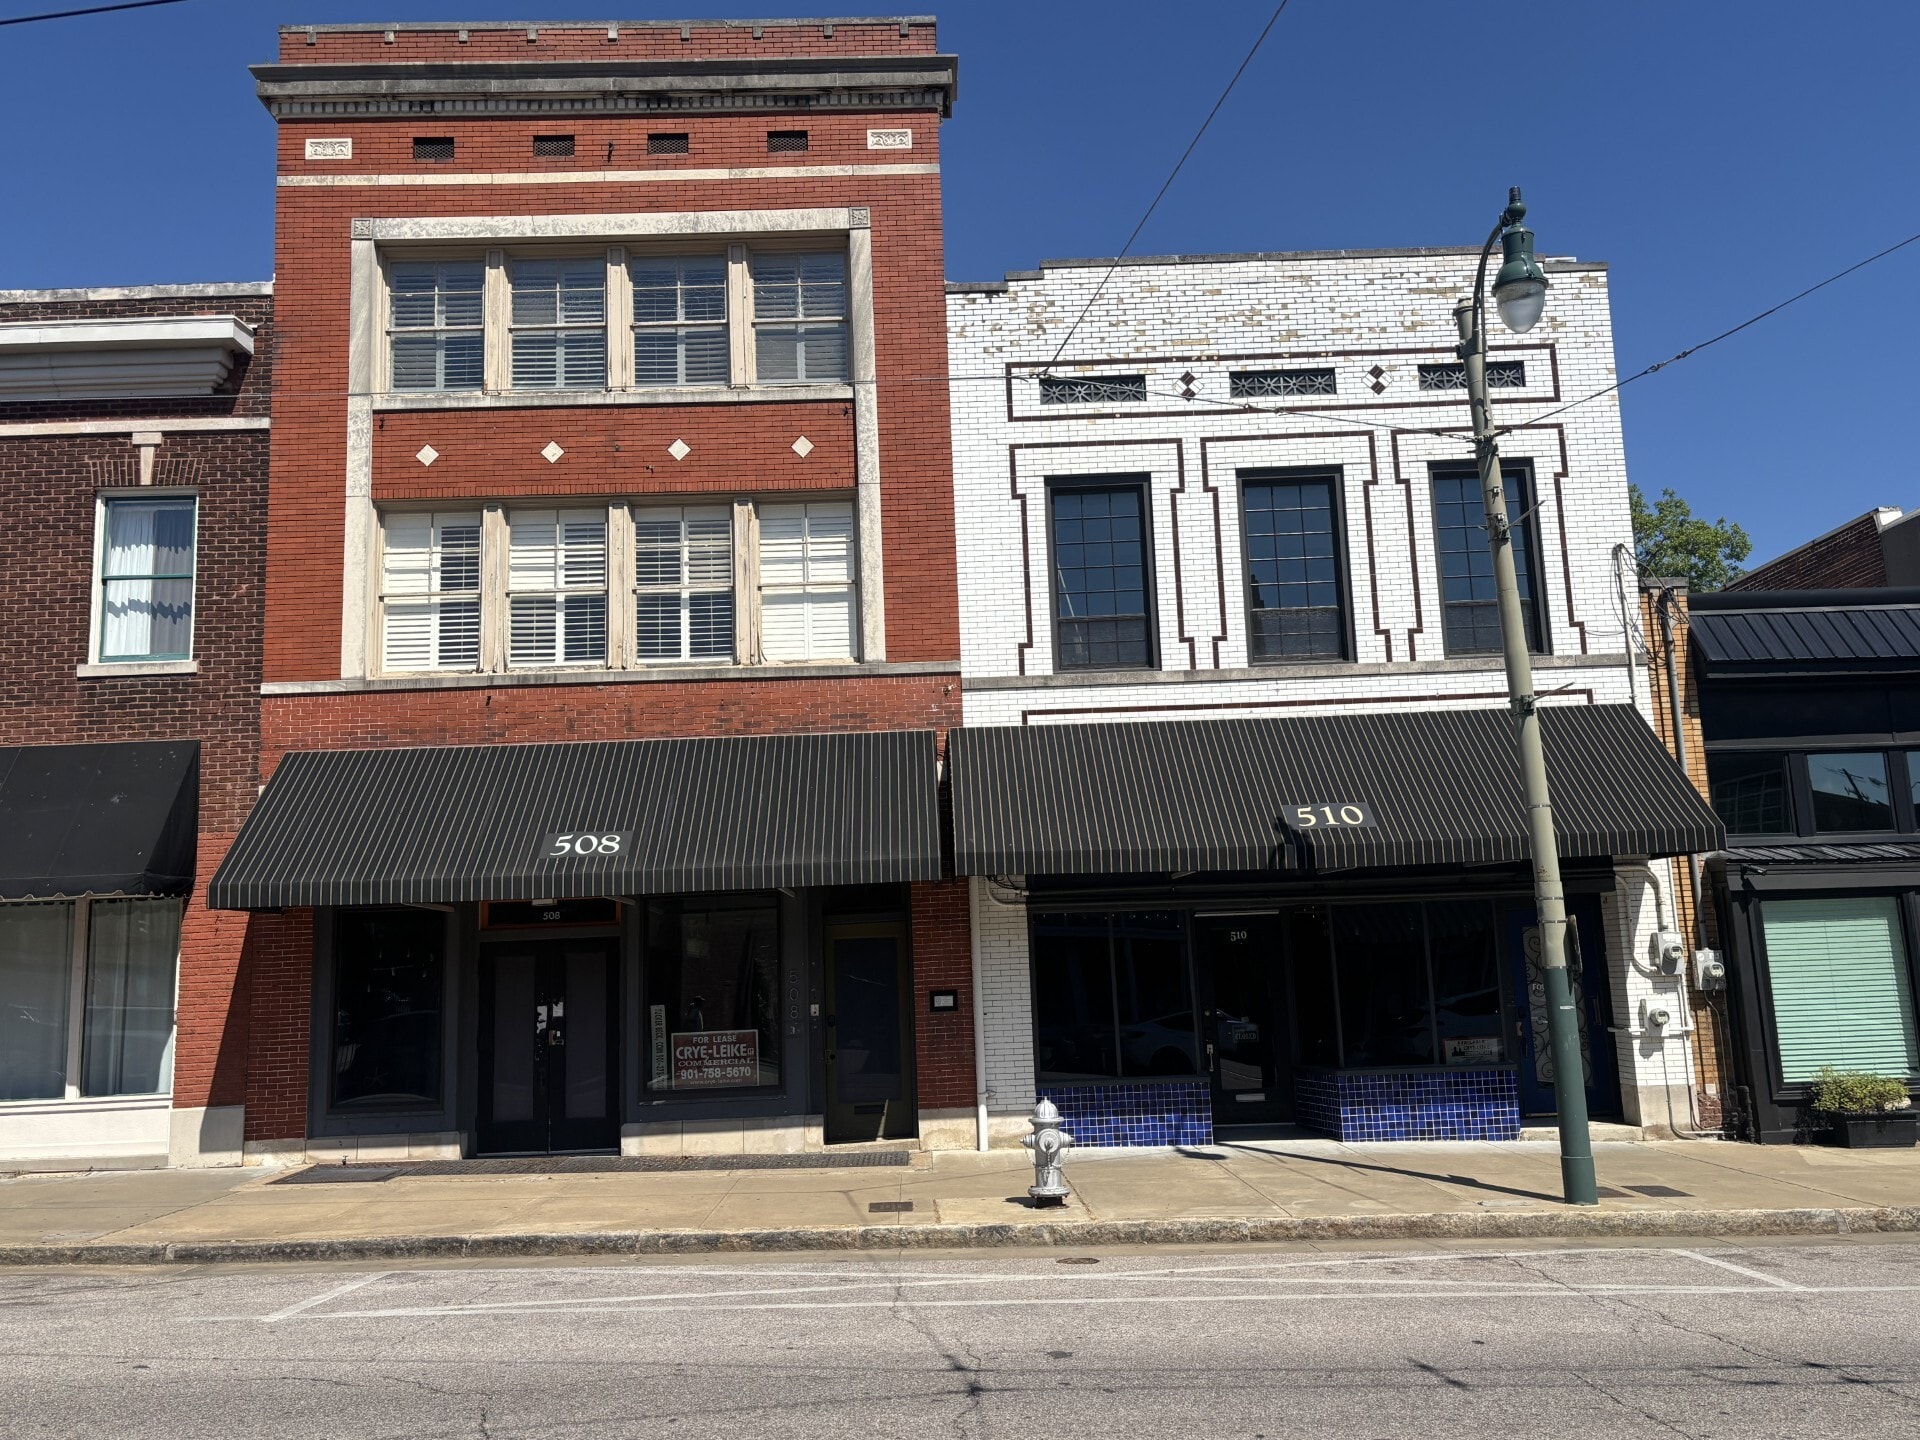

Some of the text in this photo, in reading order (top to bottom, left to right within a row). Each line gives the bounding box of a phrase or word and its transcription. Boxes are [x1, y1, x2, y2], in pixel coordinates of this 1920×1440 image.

[1297, 805, 1364, 827] 510
[550, 833, 621, 856] 508
[542, 911, 561, 920] 508
[1230, 930, 1247, 942] 510
[693, 1034, 737, 1044] FOR LEASE
[676, 1043, 747, 1060] CRYE-LEIKE
[678, 1057, 754, 1067] COMMERCIAL
[680, 1066, 751, 1080] 901-758-5670
